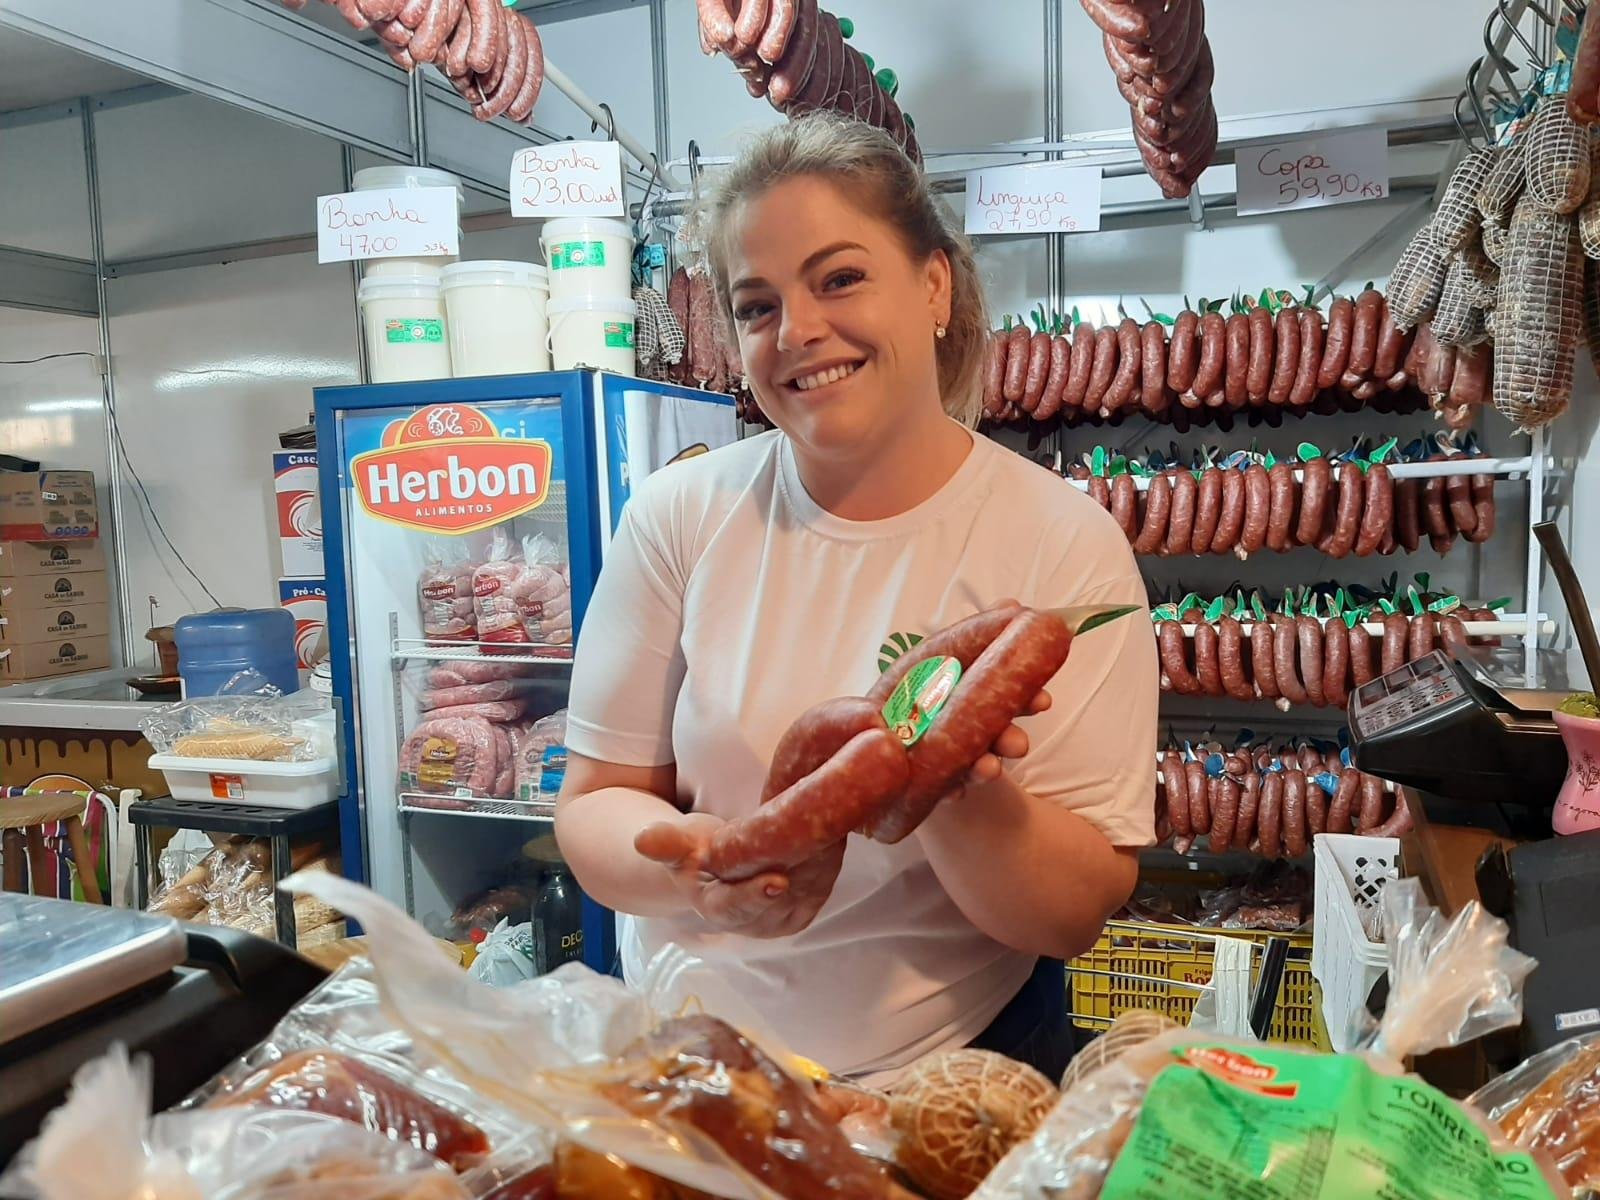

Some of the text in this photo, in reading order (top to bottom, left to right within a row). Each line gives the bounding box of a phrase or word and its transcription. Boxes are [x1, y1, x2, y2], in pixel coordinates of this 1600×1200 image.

[1258, 148, 1330, 182] Copa
[522, 176, 594, 206] 23,00
[1277, 173, 1360, 205] 59,90
[985, 208, 1051, 231] 27,90
[340, 233, 398, 256] 47,00
[288, 454, 319, 466] Casc
[367, 455, 537, 504] Herbon
[415, 503, 494, 517] ALIMENTOS
